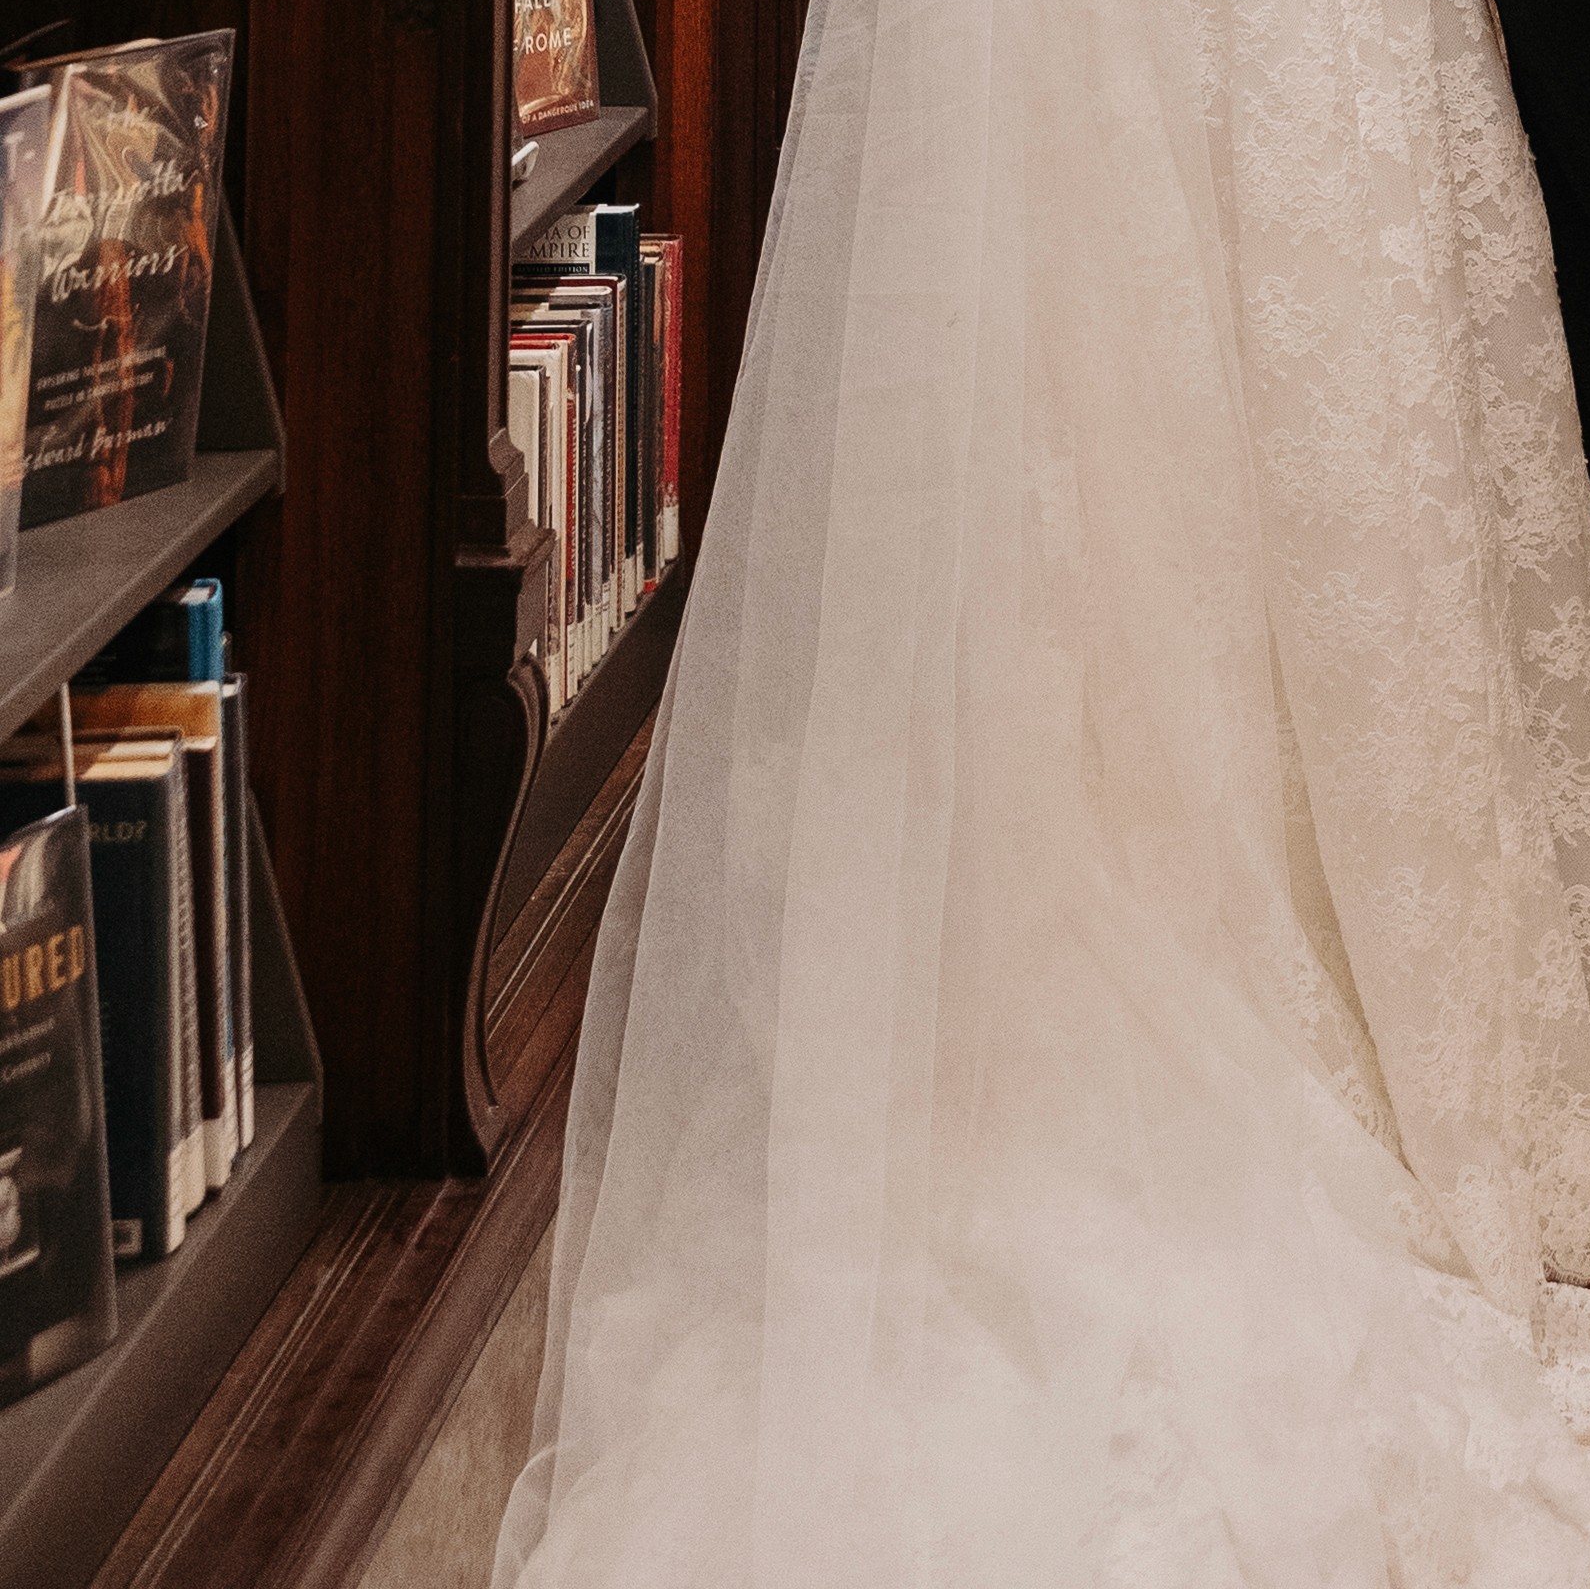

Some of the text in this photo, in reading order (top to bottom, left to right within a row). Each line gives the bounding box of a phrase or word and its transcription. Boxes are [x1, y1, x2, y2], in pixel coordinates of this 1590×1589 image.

[524, 27, 573, 56] ROME
[568, 225, 591, 240] OF
[526, 243, 590, 259] MPIRE
